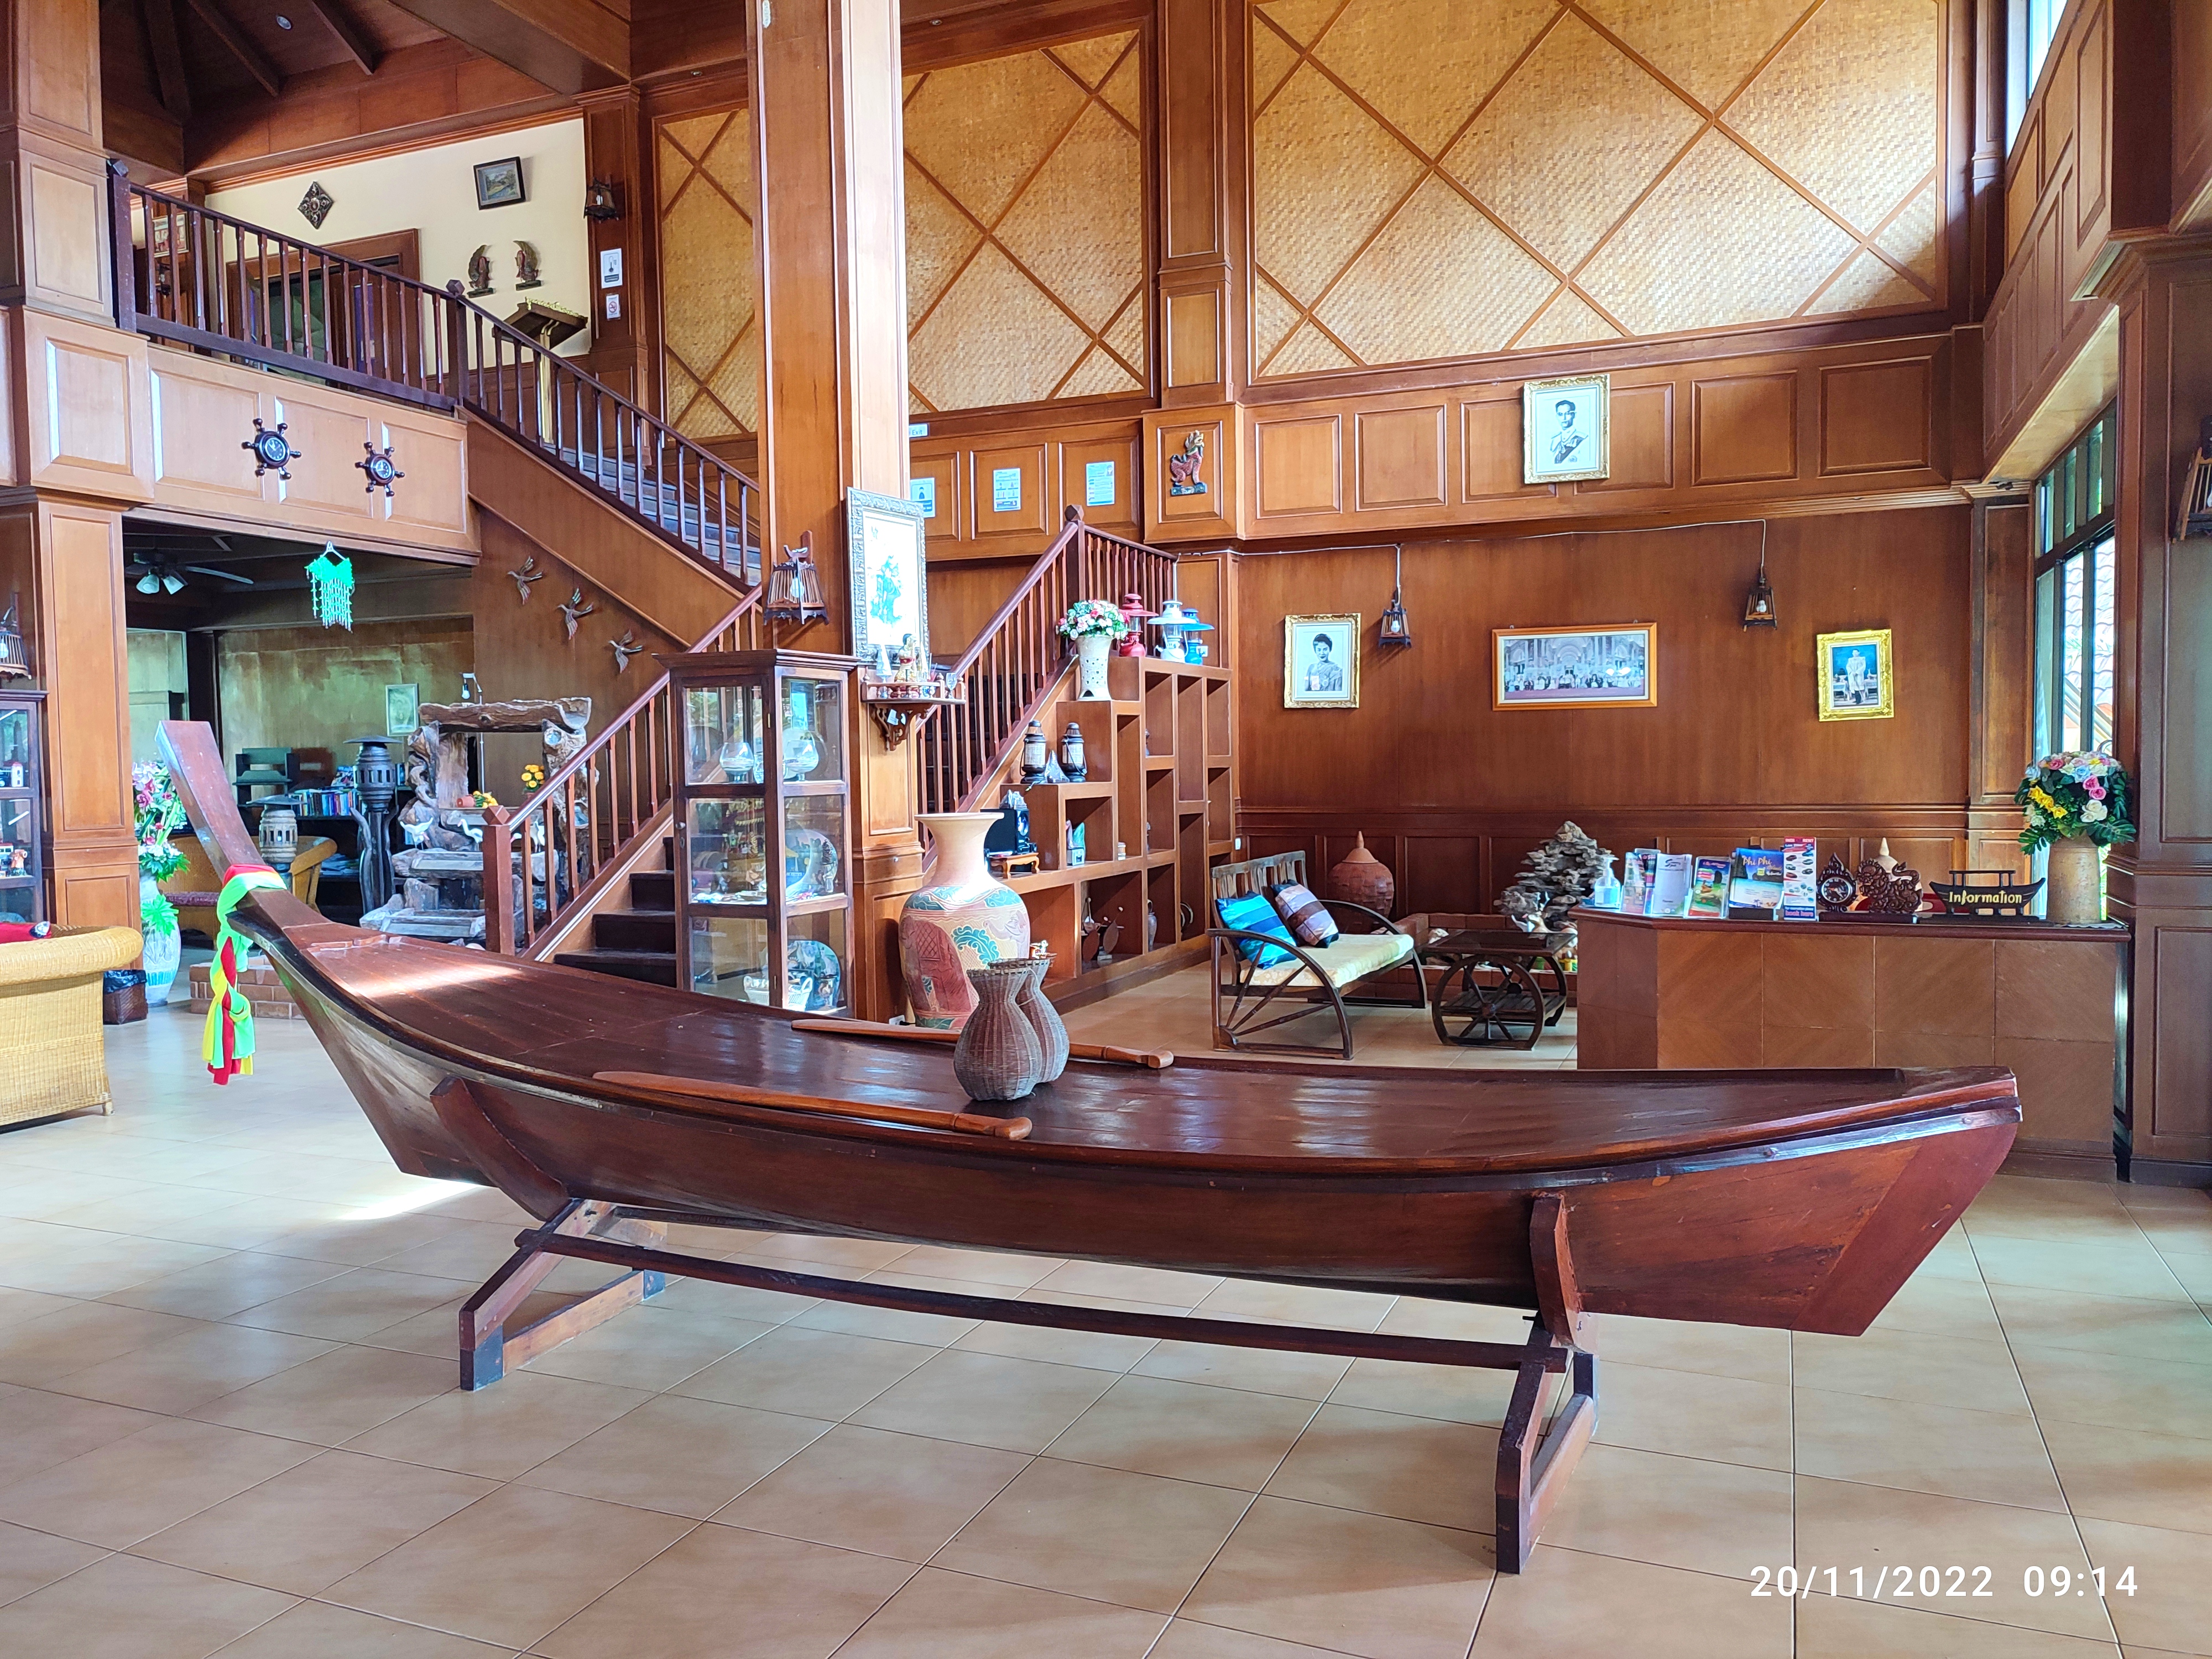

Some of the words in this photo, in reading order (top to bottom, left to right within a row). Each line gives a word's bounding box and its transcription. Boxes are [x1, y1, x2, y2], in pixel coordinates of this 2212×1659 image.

[1741, 855, 1756, 866] Phi
[1757, 855, 1772, 866] Phi
[1948, 889, 2022, 905] Information
